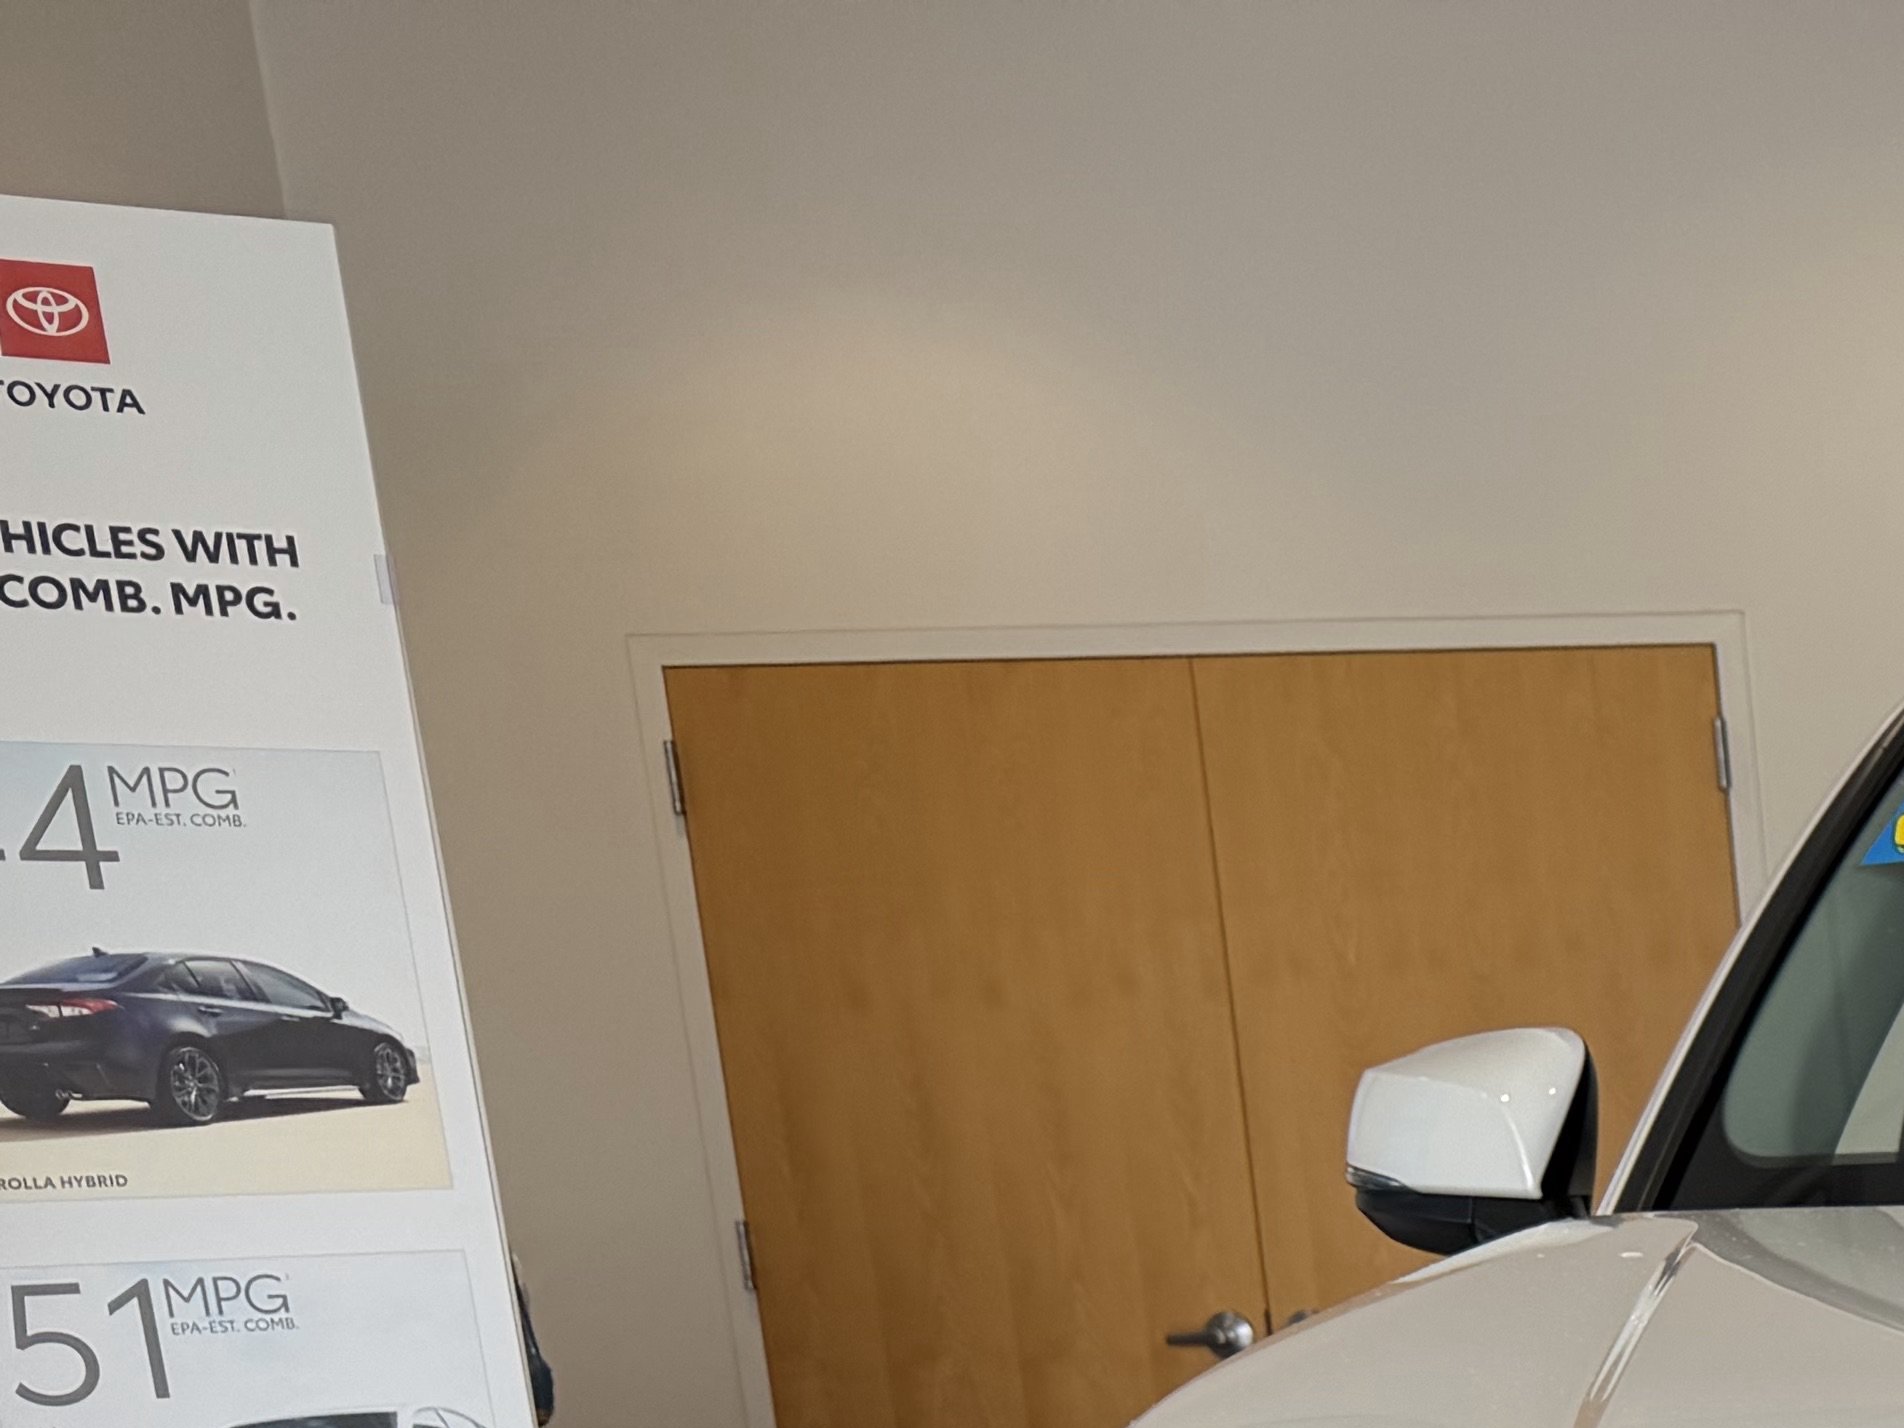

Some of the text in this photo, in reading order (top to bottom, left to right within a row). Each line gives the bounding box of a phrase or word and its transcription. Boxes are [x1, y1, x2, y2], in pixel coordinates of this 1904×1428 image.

[0, 379, 146, 415] OYOTA
[171, 528, 300, 568] WITH
[0, 573, 297, 621] COMB. MPG.
[0, 764, 239, 890] 4 MPG
[116, 811, 247, 828] EPA-EST. COMB.
[60, 1174, 128, 1189] HYBRID
[11, 1274, 291, 1407] 51 MPG
[170, 1317, 300, 1336] EPA-EST. COMB.
